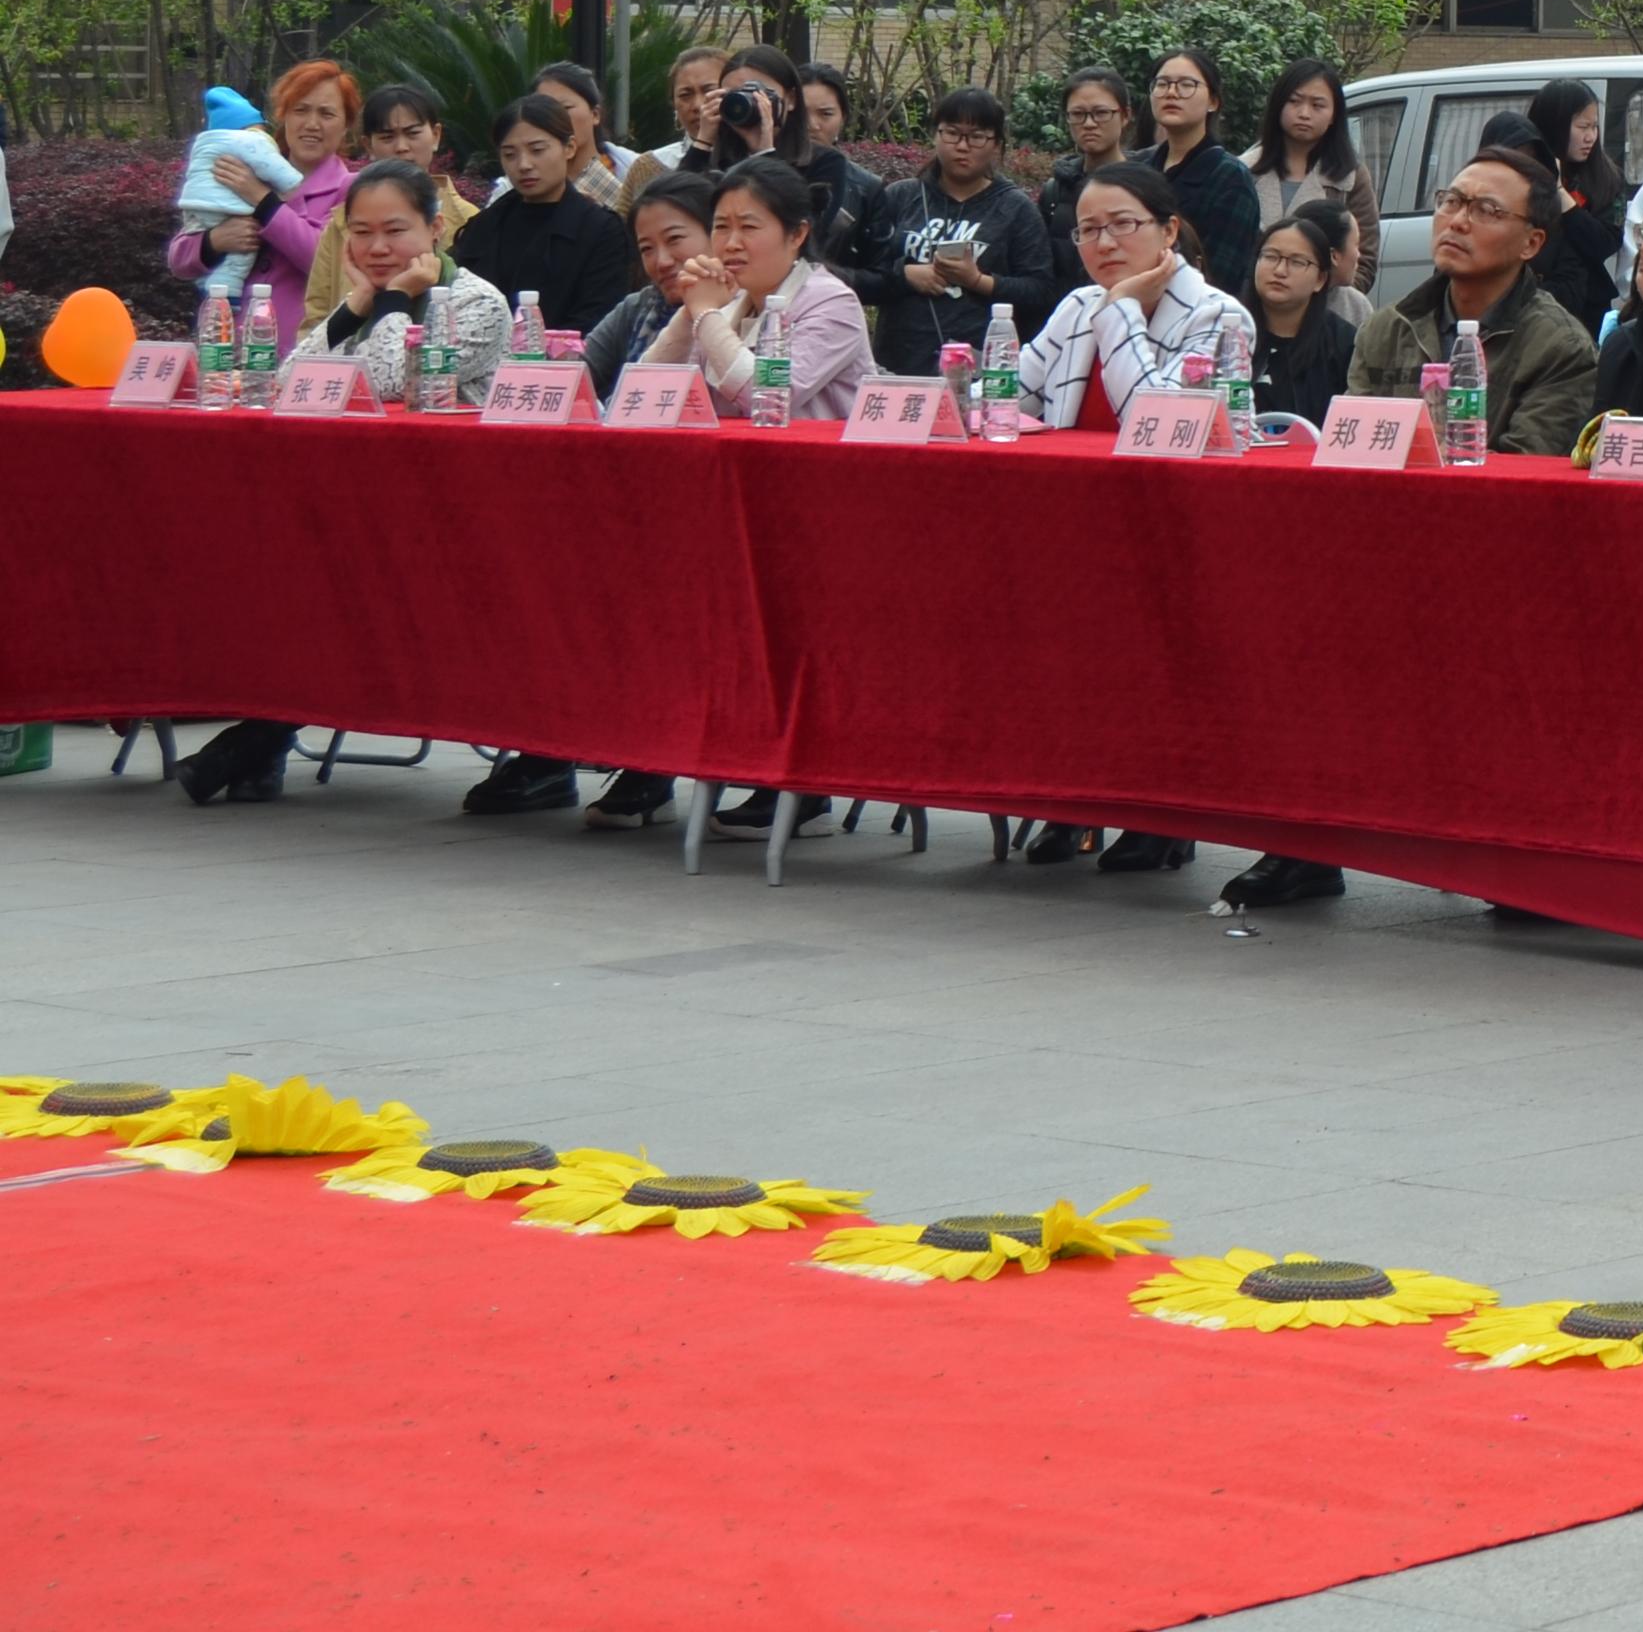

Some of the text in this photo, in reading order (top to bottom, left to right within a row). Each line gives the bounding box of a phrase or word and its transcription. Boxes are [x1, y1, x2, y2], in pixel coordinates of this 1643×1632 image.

[904, 231, 990, 264] REY
[490, 384, 567, 413] 陈秀丽
[622, 388, 677, 417] 李平
[860, 392, 926, 423] 陈露
[1131, 416, 1200, 449] 祝刚
[1328, 417, 1400, 451] 郑翔
